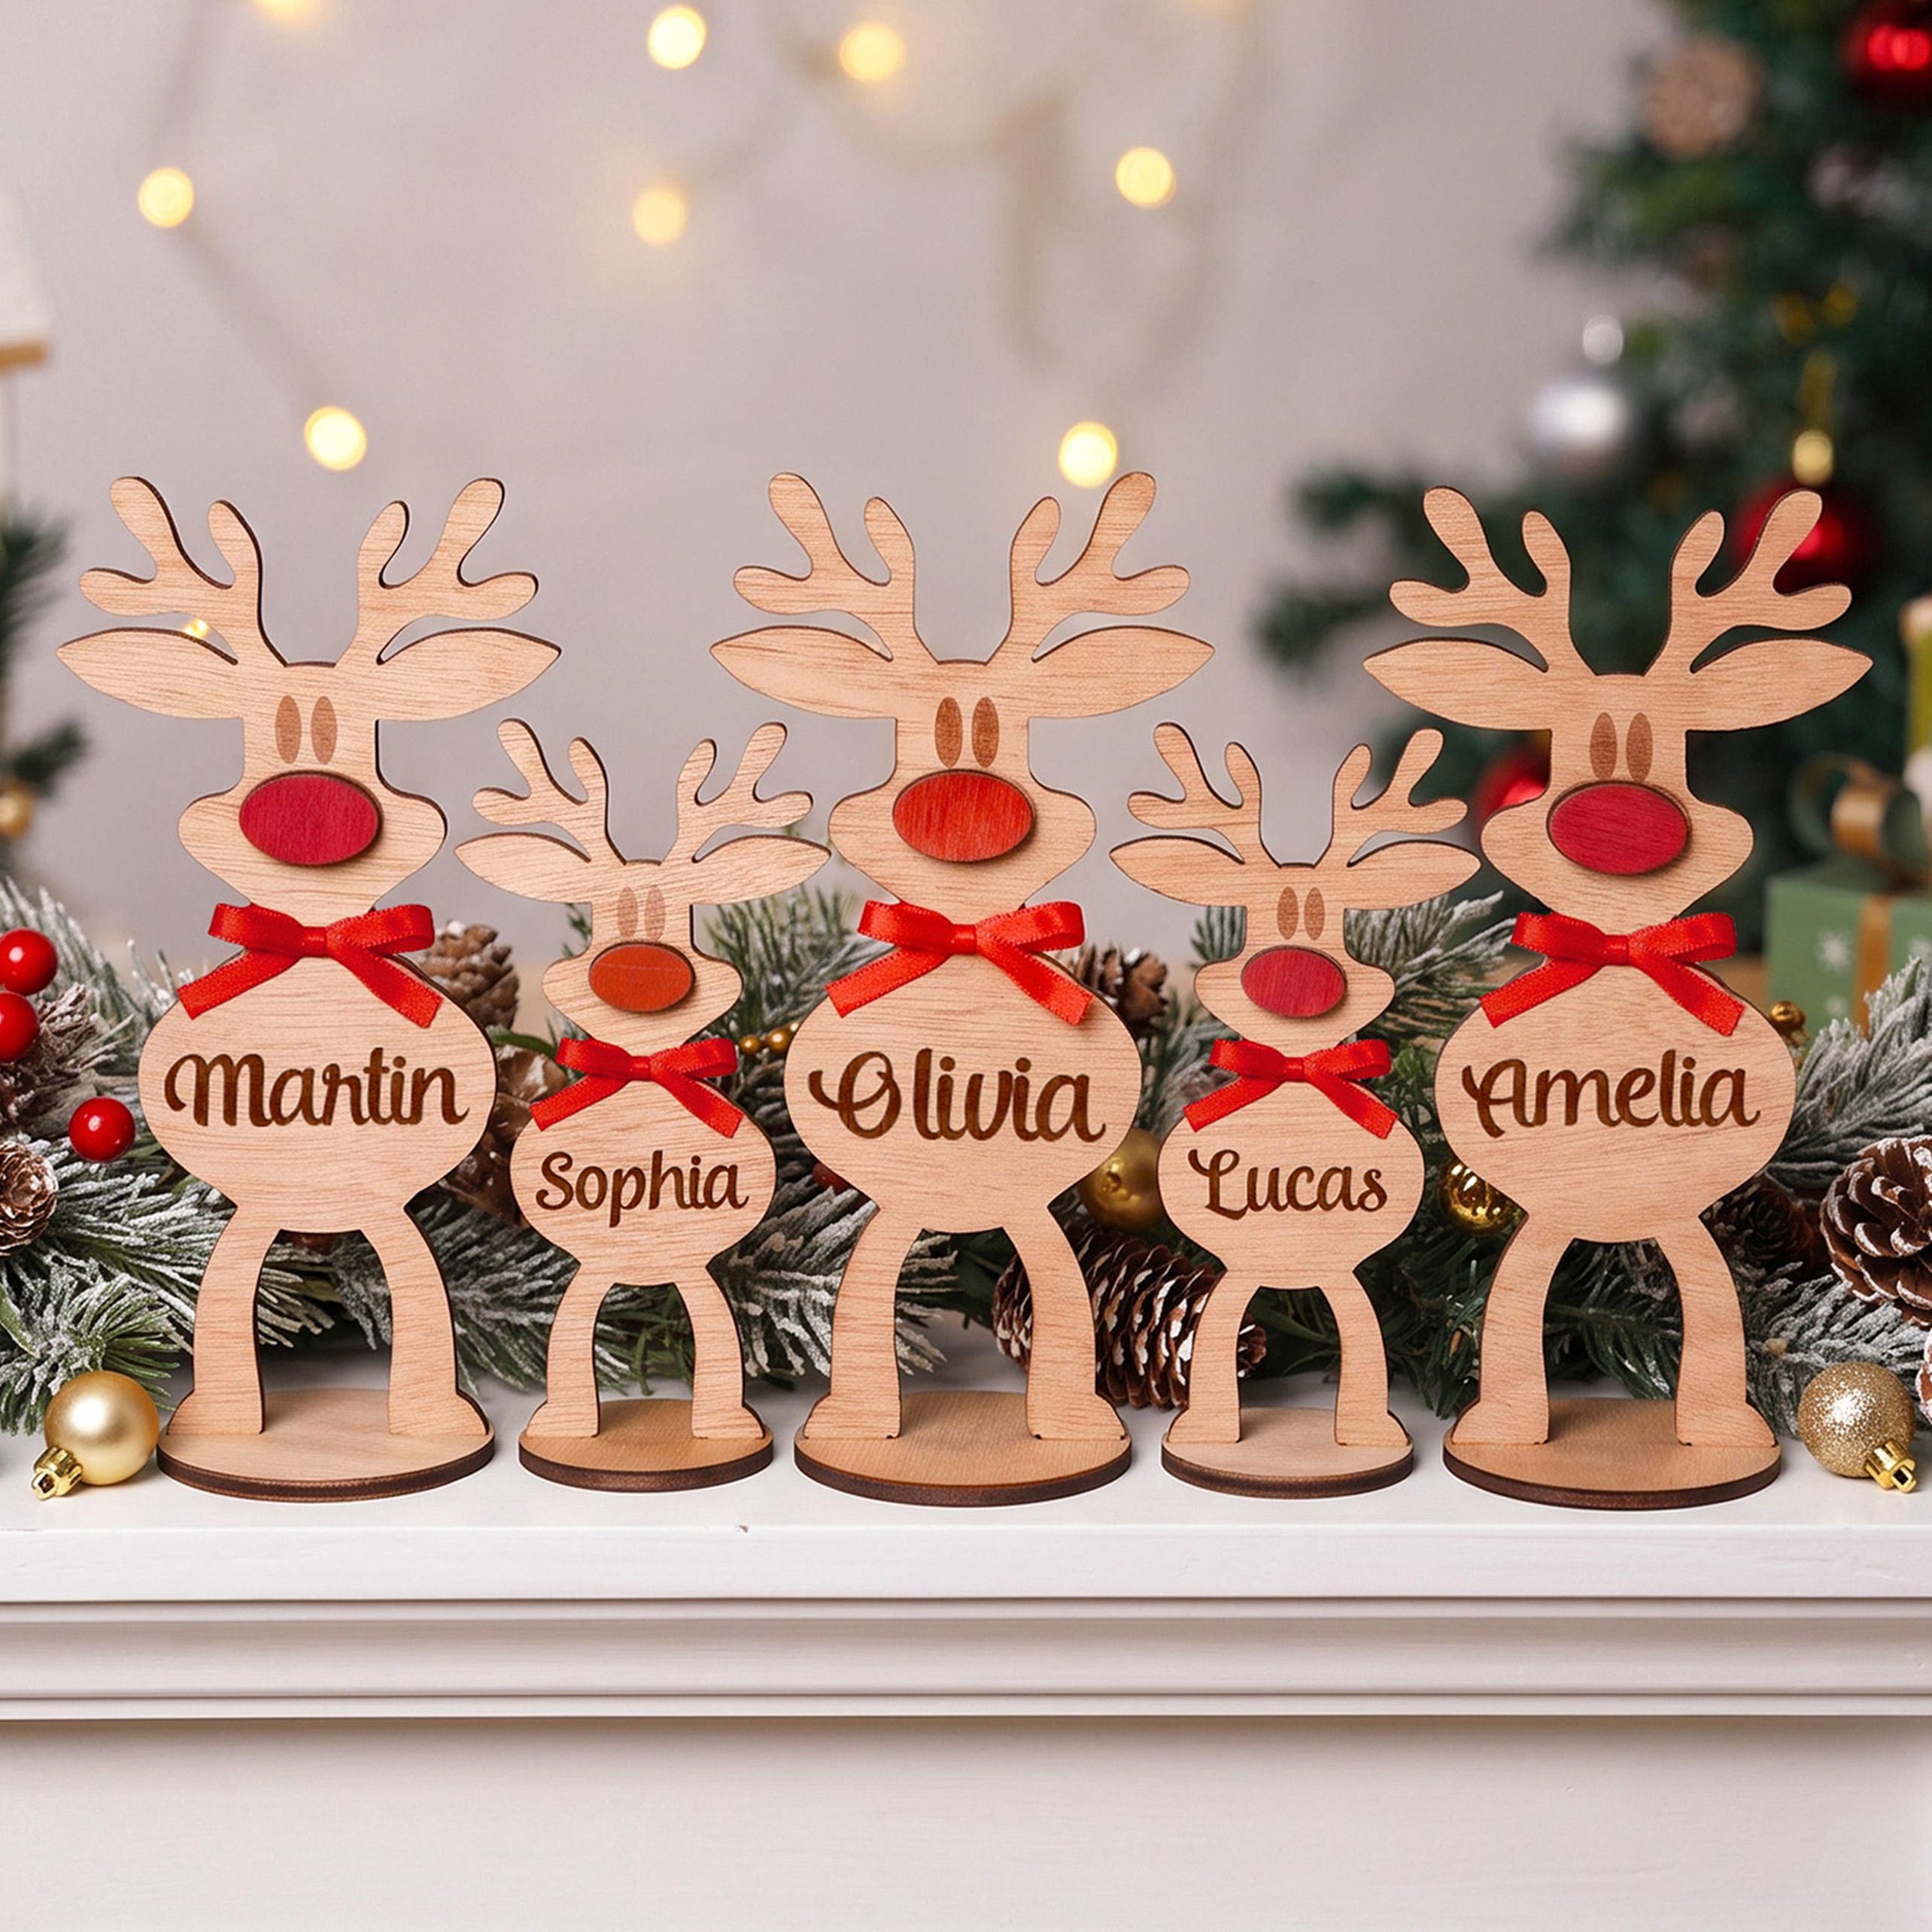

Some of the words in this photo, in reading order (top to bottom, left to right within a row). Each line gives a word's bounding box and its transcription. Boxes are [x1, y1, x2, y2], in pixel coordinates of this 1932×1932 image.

[164, 1046, 470, 1128] Martin
[807, 1047, 1107, 1143] Olivia
[1461, 1049, 1761, 1139] Amelia
[535, 1150, 750, 1229] Sophia
[1187, 1149, 1388, 1221] Lucas
